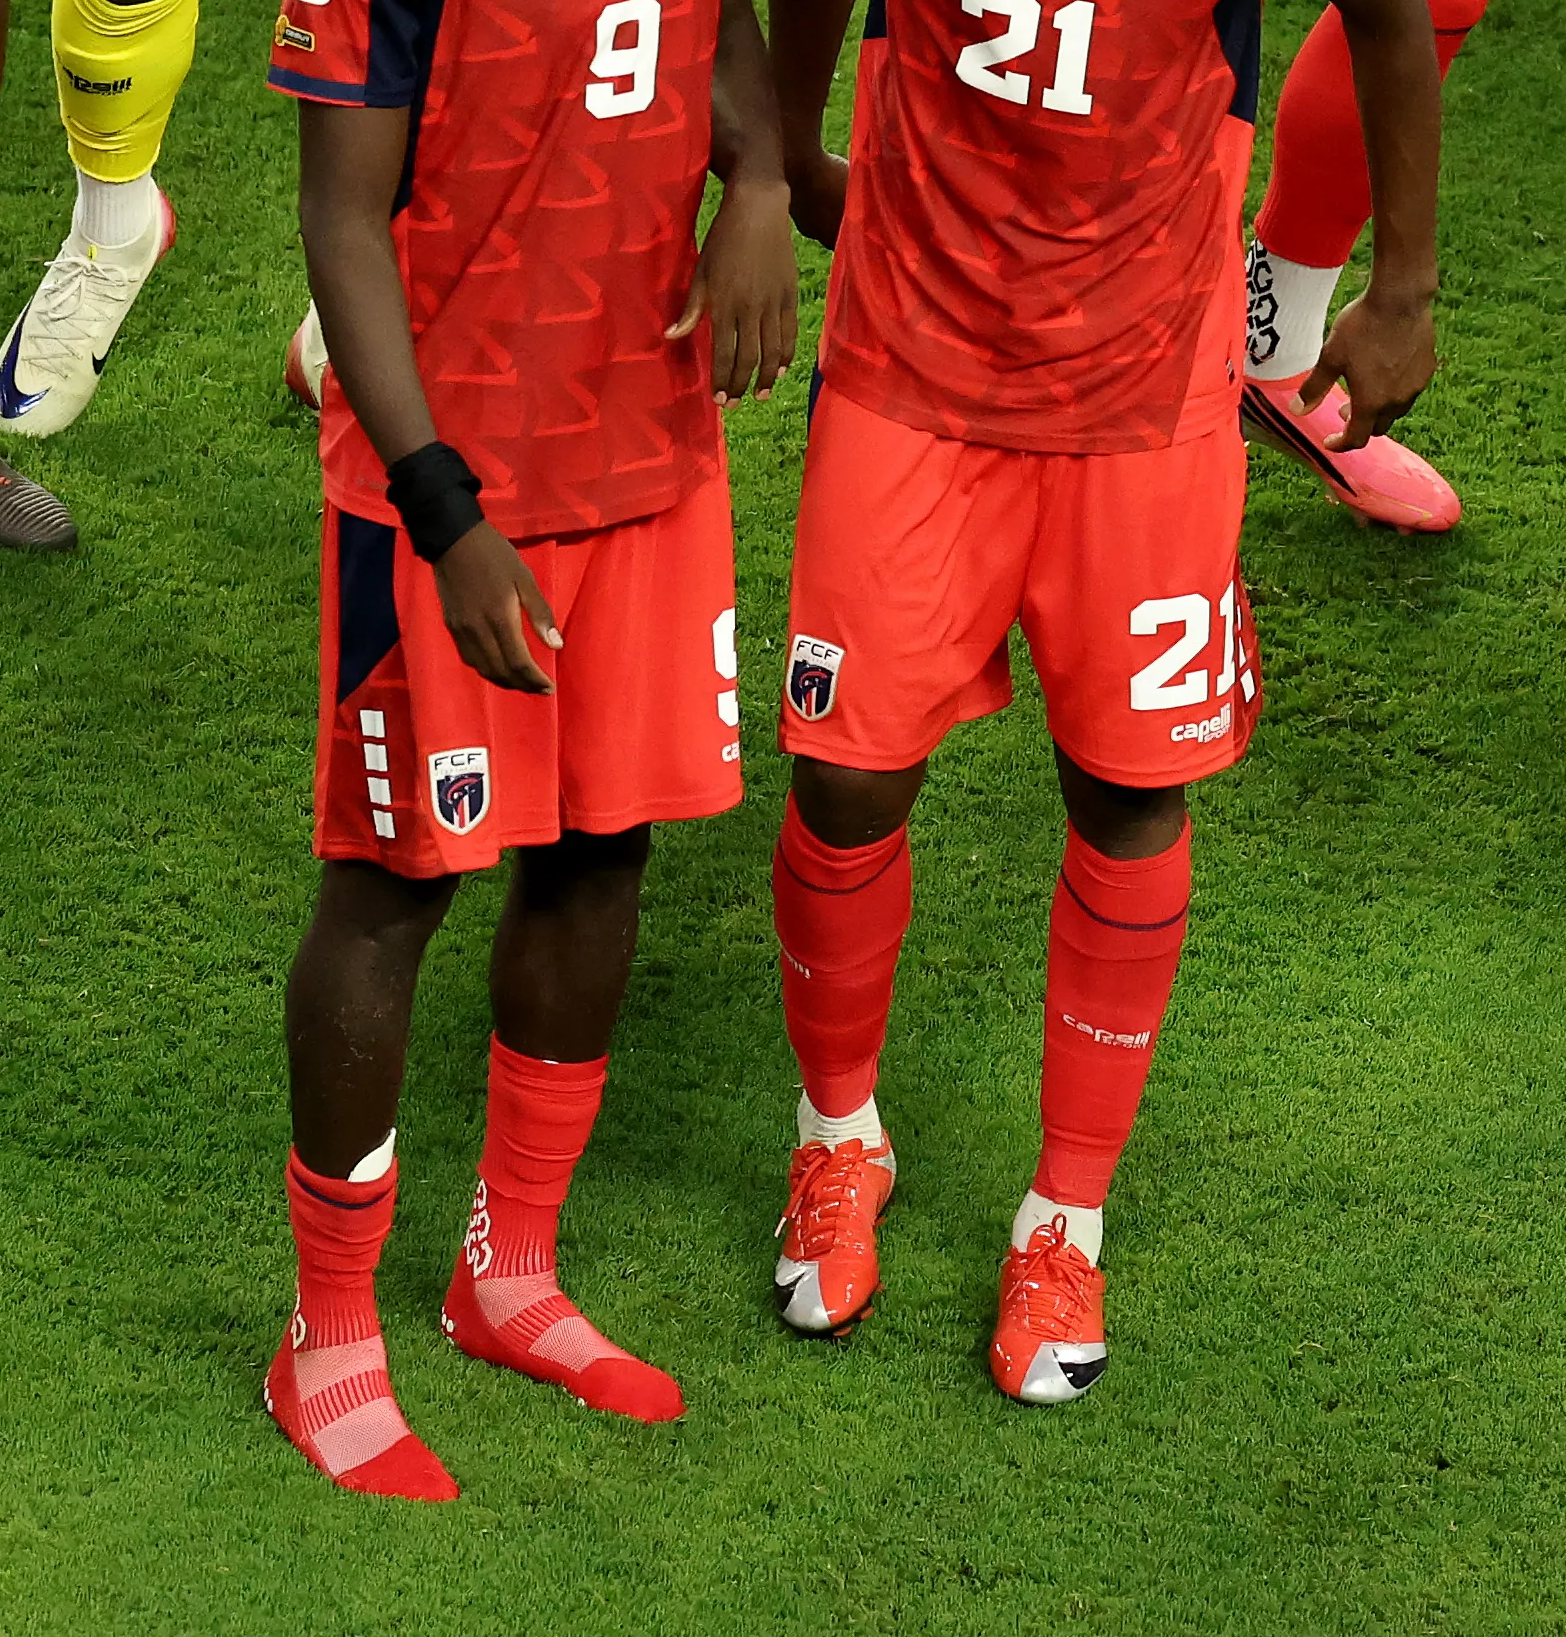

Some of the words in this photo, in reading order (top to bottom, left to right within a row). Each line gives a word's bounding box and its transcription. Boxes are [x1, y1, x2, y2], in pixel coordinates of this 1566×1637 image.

[797, 640, 839, 659] FCF
[1130, 579, 1236, 711] 21
[1170, 703, 1232, 743] capelli
[434, 752, 482, 770] FCF
[1063, 1014, 1151, 1044] capelli
